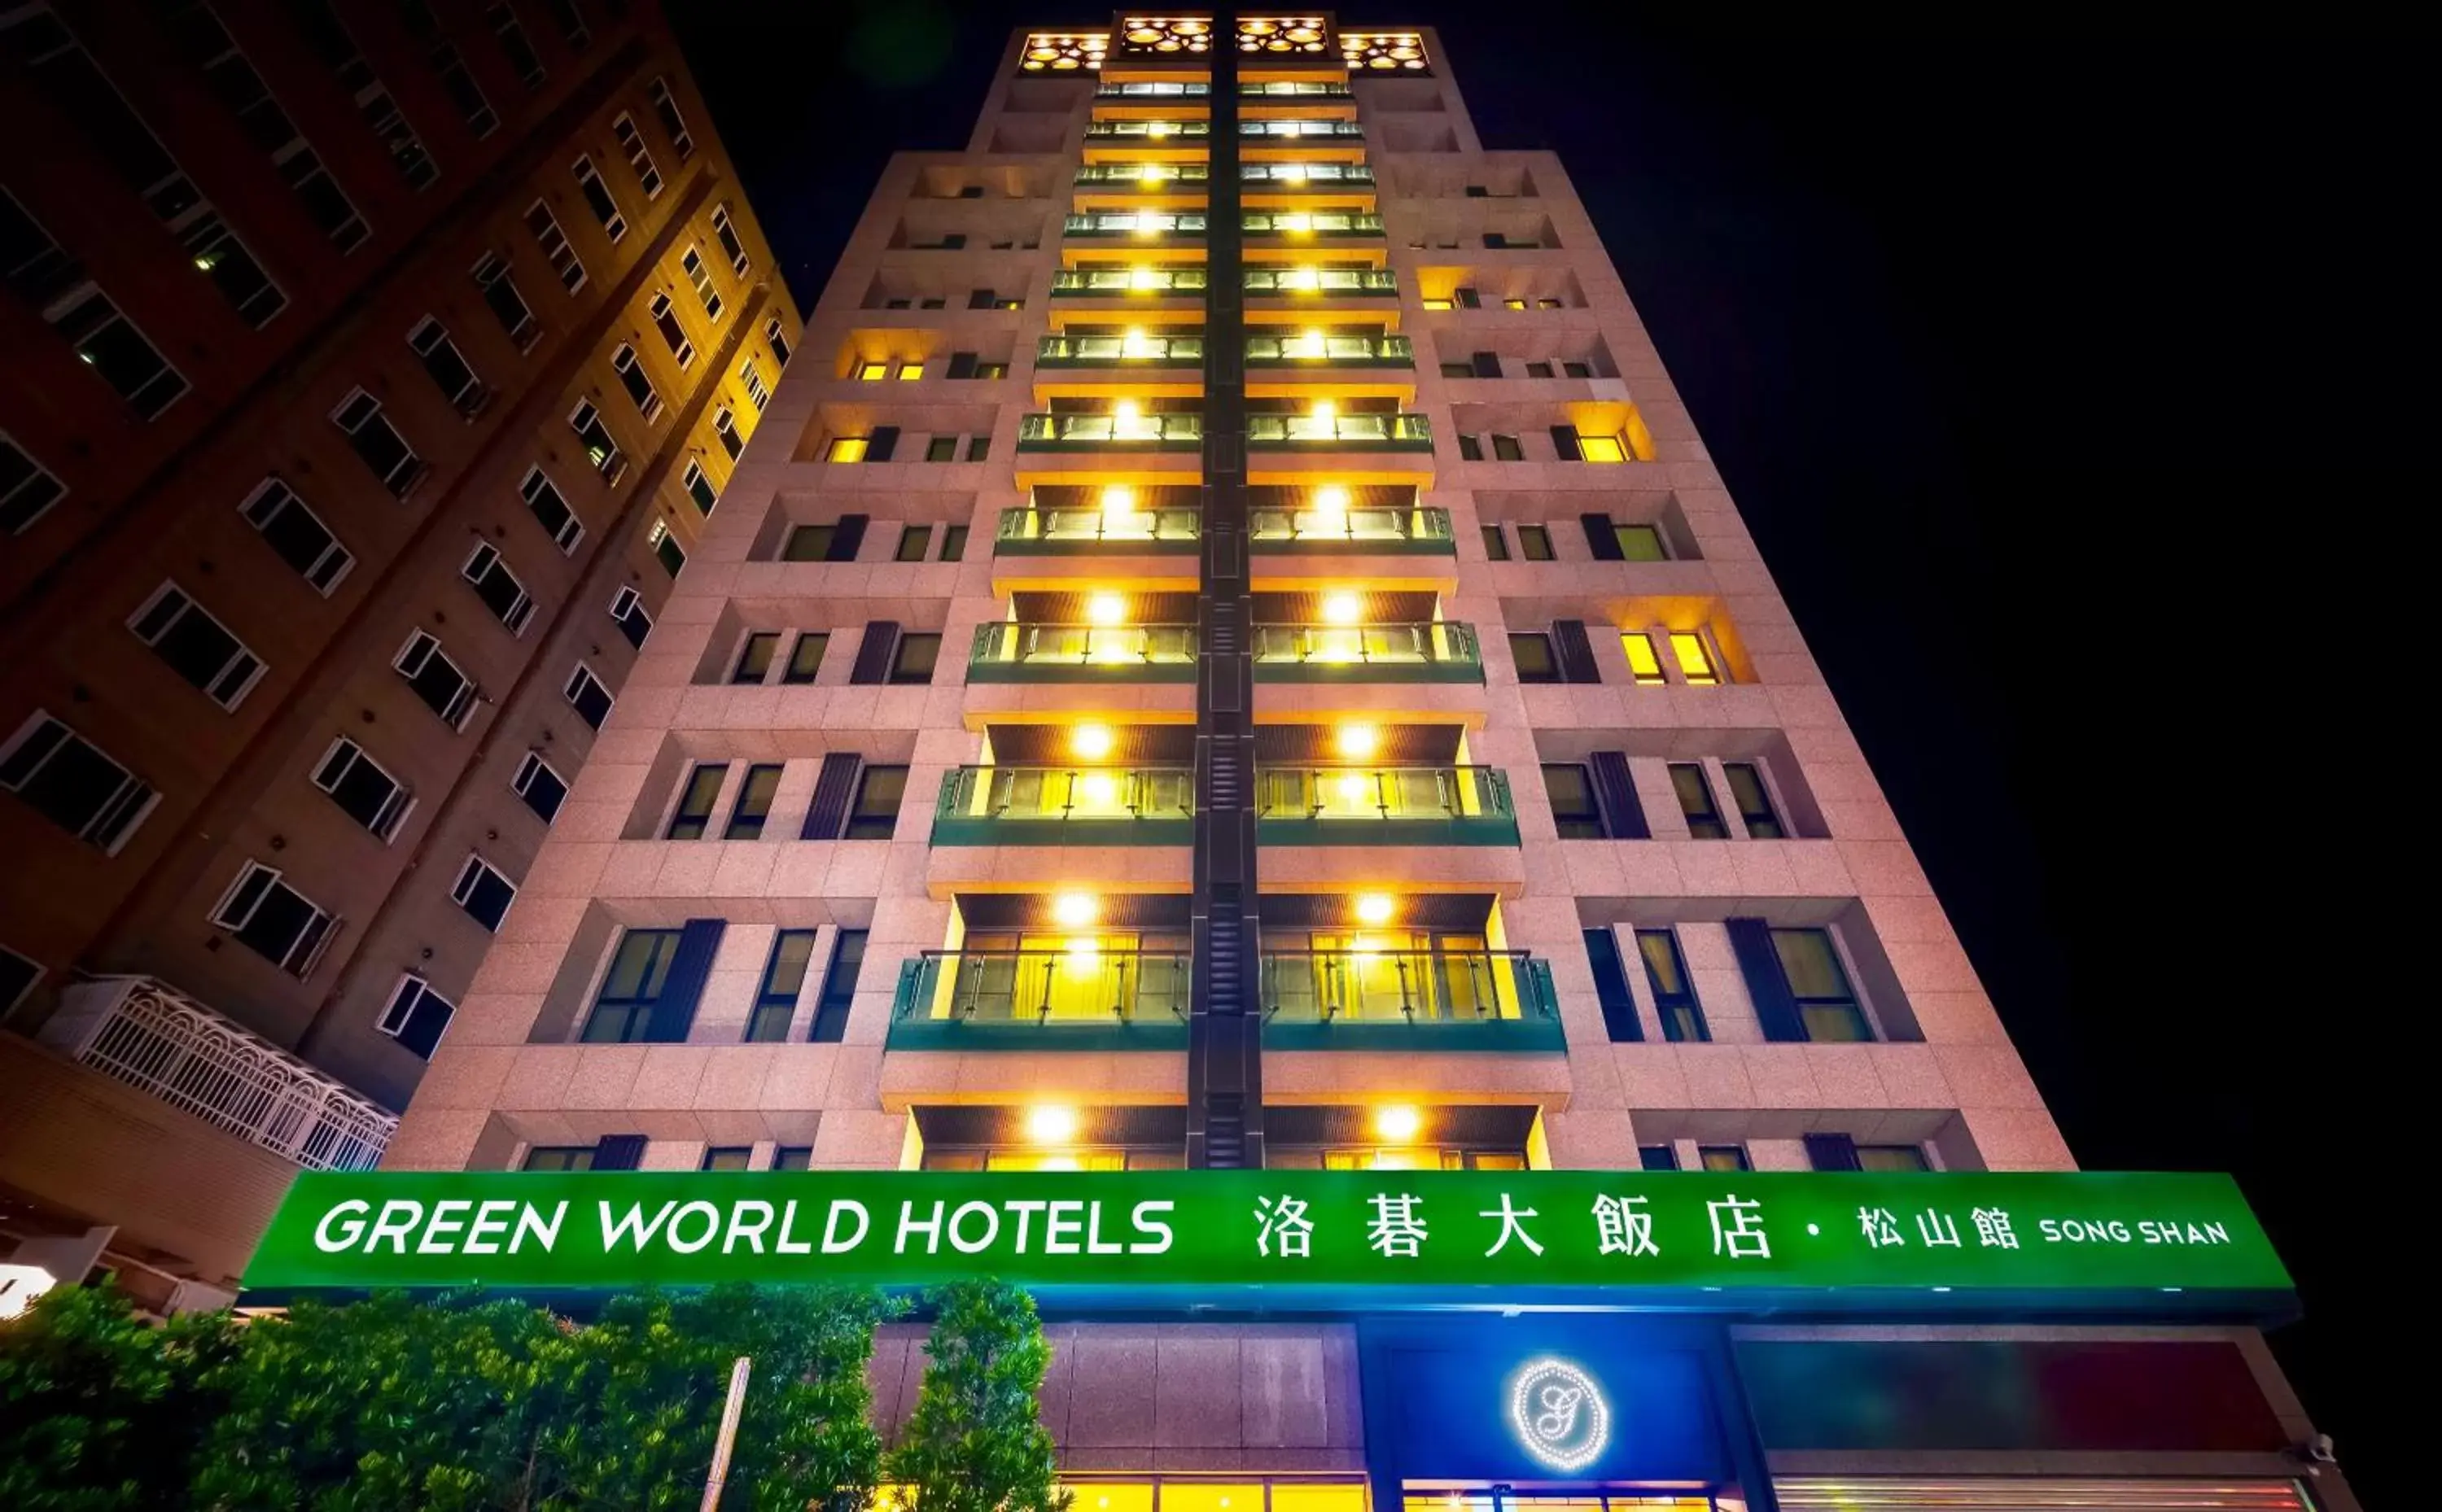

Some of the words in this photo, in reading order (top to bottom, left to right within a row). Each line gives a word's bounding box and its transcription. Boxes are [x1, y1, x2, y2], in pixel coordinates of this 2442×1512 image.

[313, 1199, 570, 1255] GREEN
[598, 1200, 870, 1255] WORLD
[893, 1200, 1175, 1255] HOTELS
[1253, 1192, 1771, 1259] 洛碁大飯店
[1857, 1205, 2020, 1250] 松山館
[2038, 1219, 2132, 1243] SONG
[2138, 1221, 2230, 1245] SHAN
